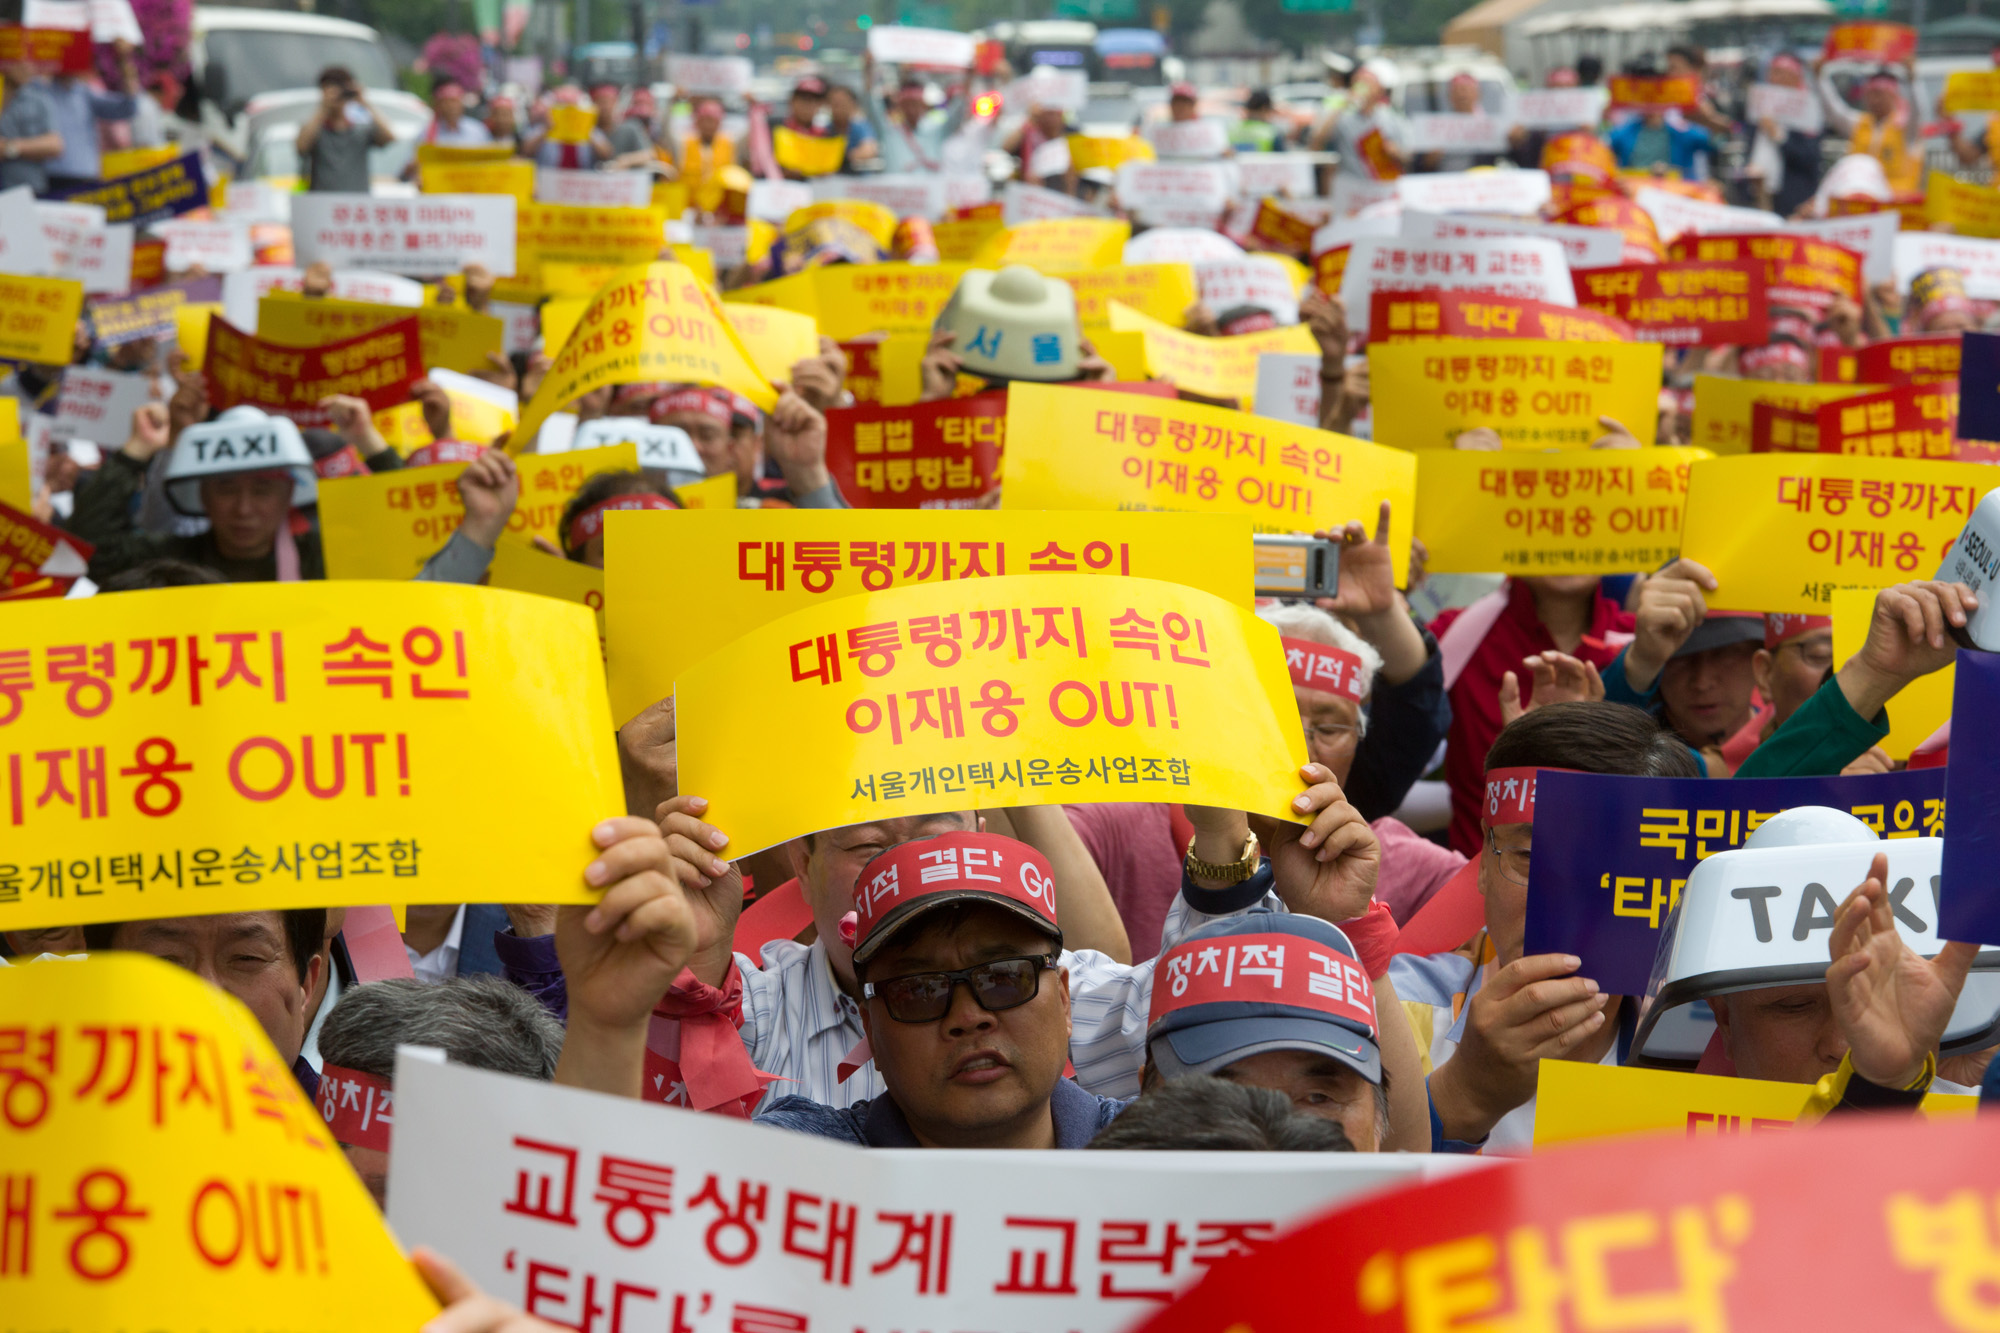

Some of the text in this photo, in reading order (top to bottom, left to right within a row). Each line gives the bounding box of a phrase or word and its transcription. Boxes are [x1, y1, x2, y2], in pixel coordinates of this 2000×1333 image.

[1423, 355, 1614, 384] 대통령까지 속인
[1531, 389, 1592, 416] OUT!
[191, 431, 279, 464] TAXI
[854, 420, 914, 454] 불법
[1095, 410, 1343, 483] 대통령까지 속인
[534, 464, 585, 493] 속인
[855, 455, 983, 493] 대통령님,
[1236, 475, 1313, 516] OUT!
[1479, 466, 1634, 499] 대통령까지
[1608, 506, 1680, 534] OUT!
[1776, 475, 1977, 521] 대통령까지
[737, 540, 1006, 595] 대통령까지
[322, 626, 471, 701] 속인
[788, 606, 1212, 686] 대통령까지 속인
[845, 679, 1180, 746] 이재웅 OUT!
[228, 733, 412, 801] OUT!
[849, 757, 1192, 803] 서울개인택시운송사업조합
[1486, 777, 1536, 816] 정치
[918, 847, 1004, 885] 결단
[1019, 861, 1056, 915] GO
[1165, 943, 1373, 1016] 정치적 결단
[190, 1176, 330, 1276] OUT!
[503, 1134, 955, 1296] 교통생태계
